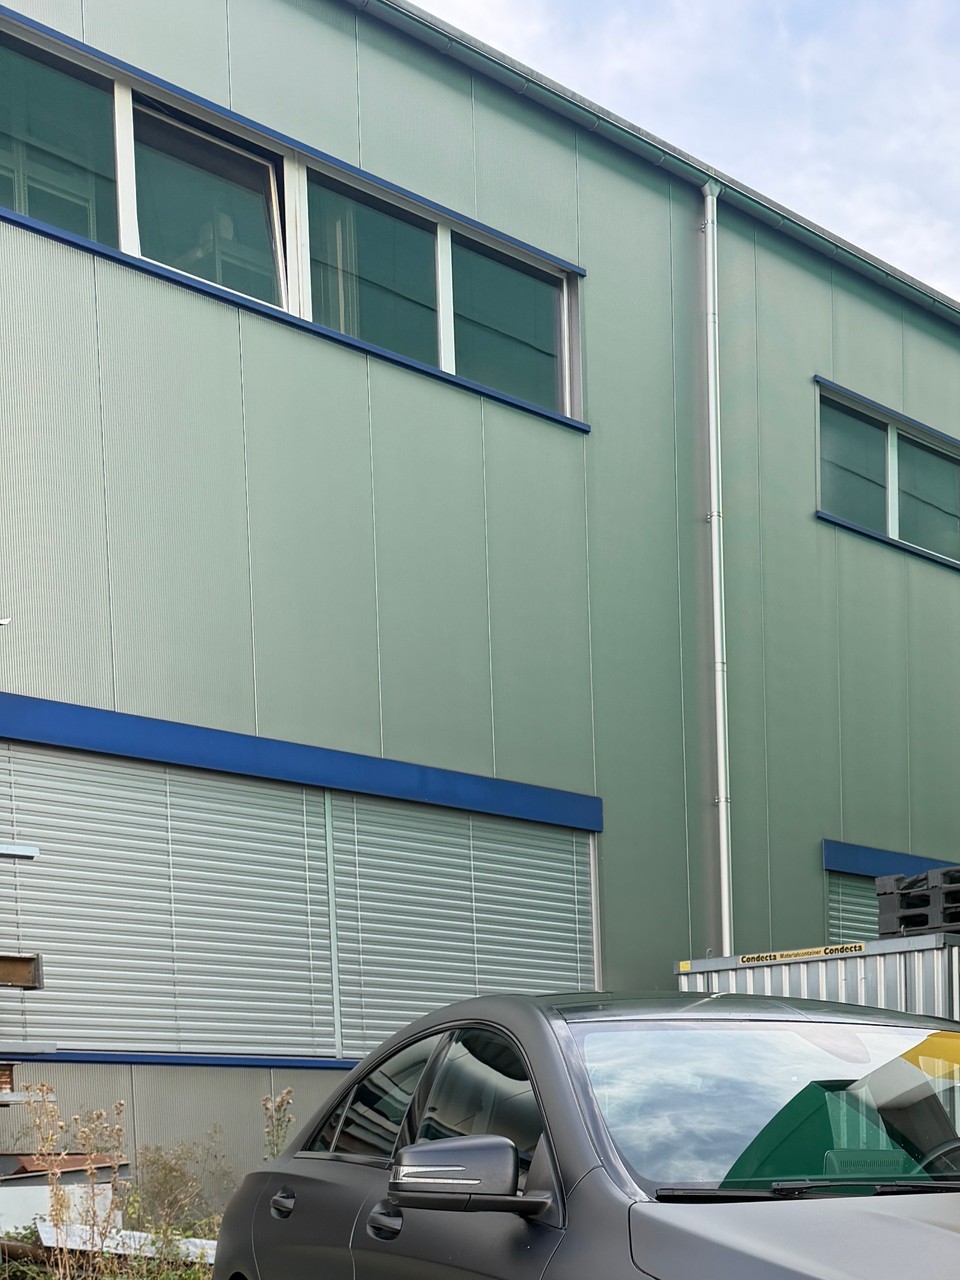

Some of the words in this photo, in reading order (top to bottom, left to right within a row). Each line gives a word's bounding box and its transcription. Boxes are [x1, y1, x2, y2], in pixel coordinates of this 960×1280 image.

[741, 953, 777, 963] Condecta
[780, 949, 822, 959] Materialcontainer
[823, 944, 863, 955] Condecta
